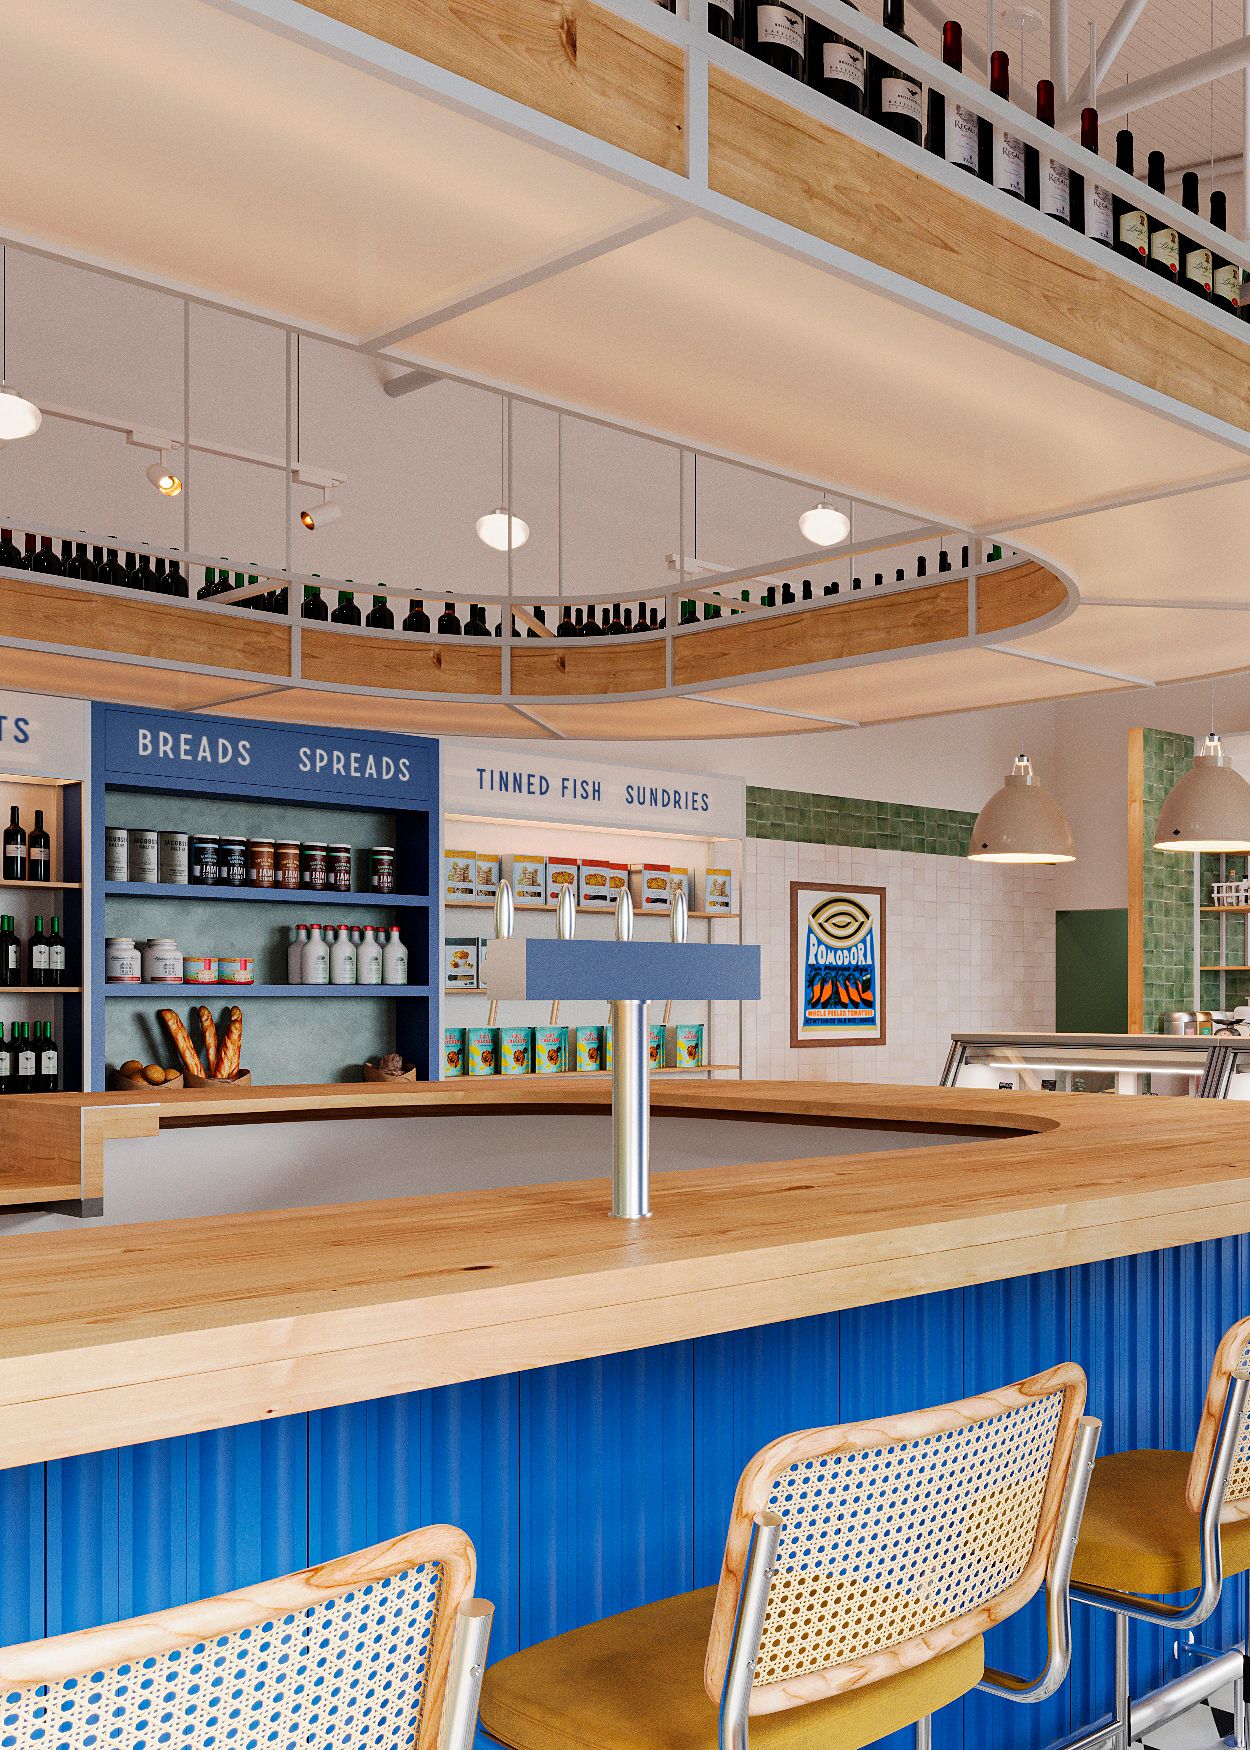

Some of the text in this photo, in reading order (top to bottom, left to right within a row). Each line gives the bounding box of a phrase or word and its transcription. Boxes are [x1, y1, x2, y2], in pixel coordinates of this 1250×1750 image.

[138, 728, 251, 766] BREADS
[299, 747, 411, 782] SPREADS
[476, 768, 601, 802] TINNED FISH
[625, 784, 709, 812] SUNDRIES
[202, 865, 217, 873] JAM
[808, 933, 873, 966] POMODORI
